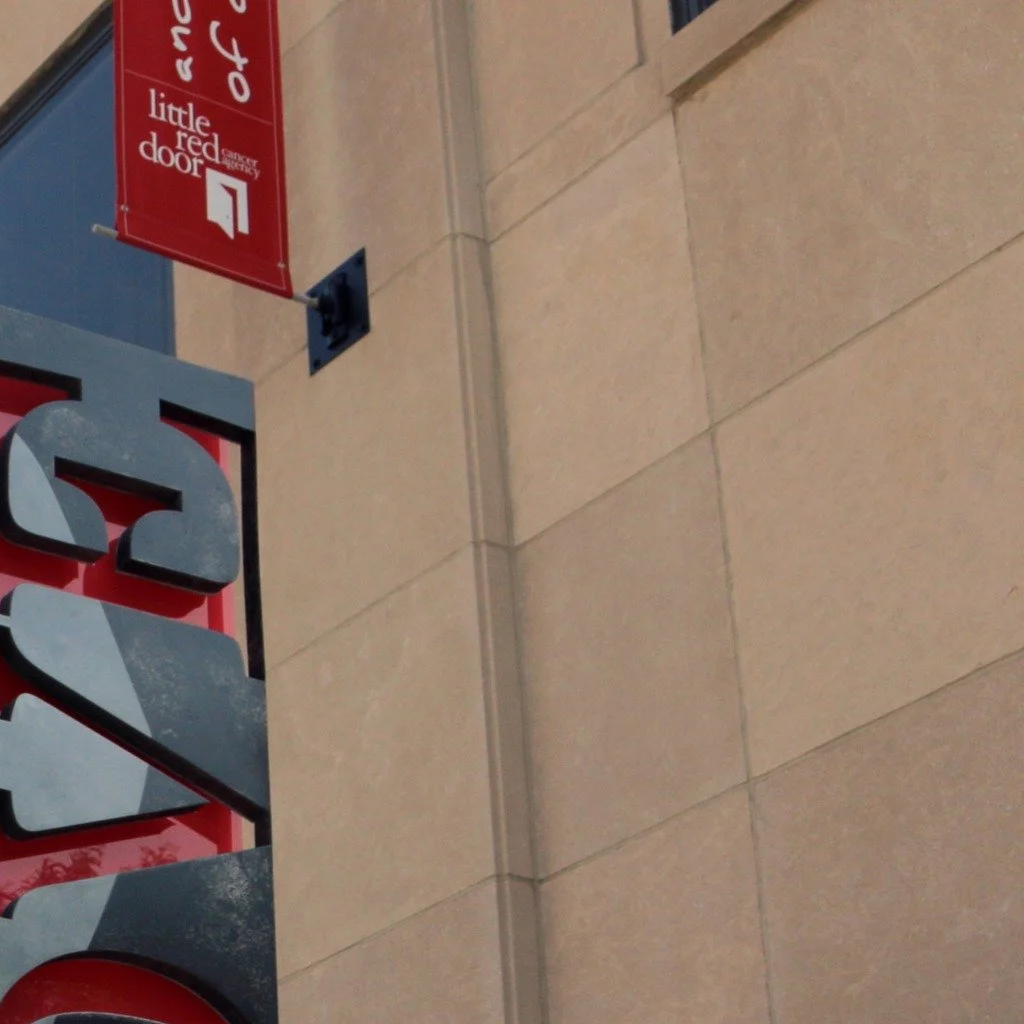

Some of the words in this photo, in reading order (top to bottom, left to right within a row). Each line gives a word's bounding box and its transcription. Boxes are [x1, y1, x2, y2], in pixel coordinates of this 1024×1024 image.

[209, 20, 251, 104] of
[148, 88, 211, 137] little
[138, 132, 202, 179] door
[175, 130, 221, 164] red
